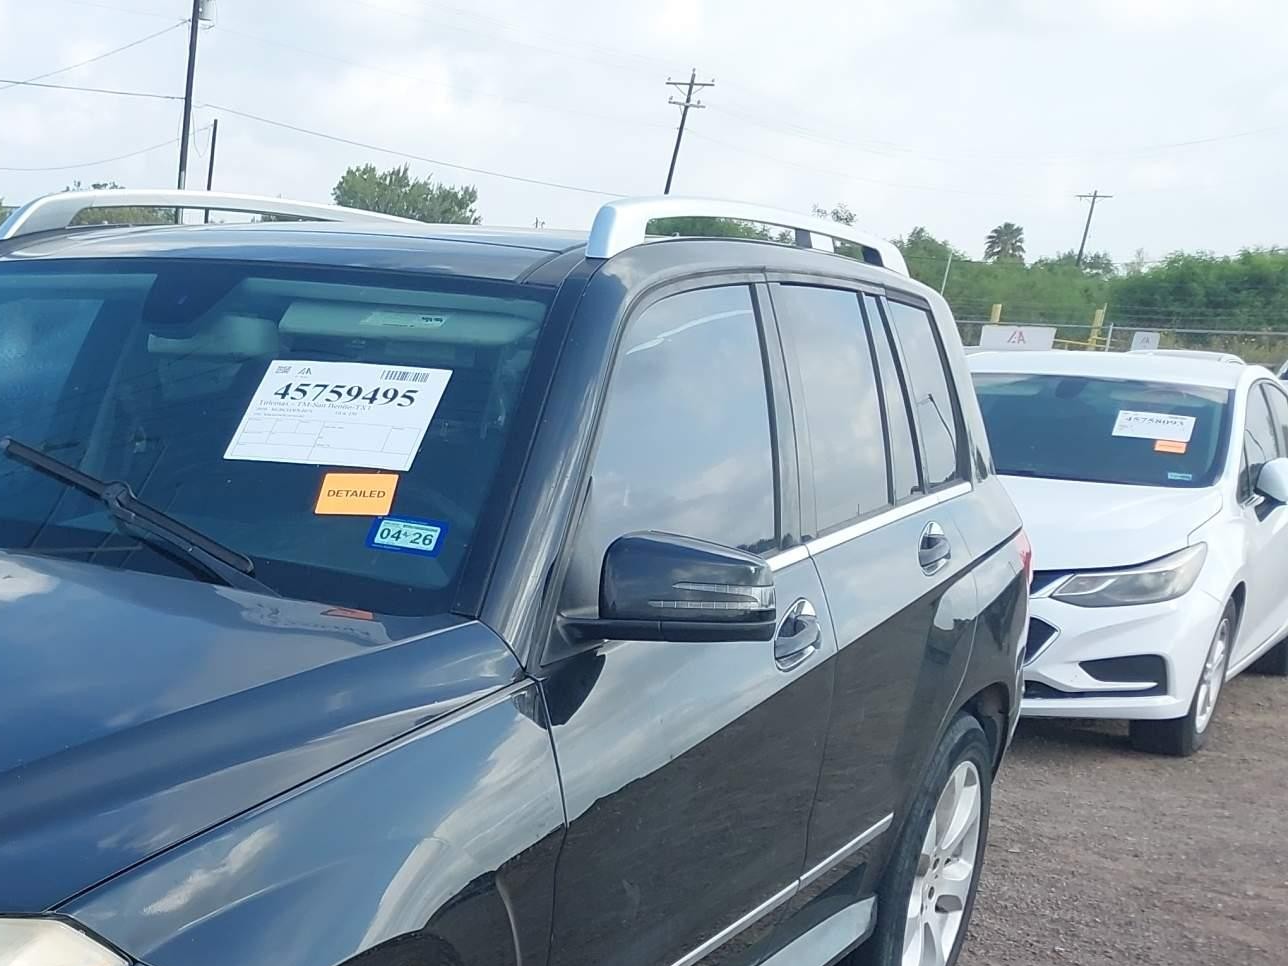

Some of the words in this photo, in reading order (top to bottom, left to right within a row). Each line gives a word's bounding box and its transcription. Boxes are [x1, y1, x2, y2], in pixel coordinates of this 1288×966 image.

[274, 382, 419, 407] 45759495
[326, 489, 386, 499] DETAILED
[380, 527, 402, 541] 04
[410, 532, 434, 546] 26
